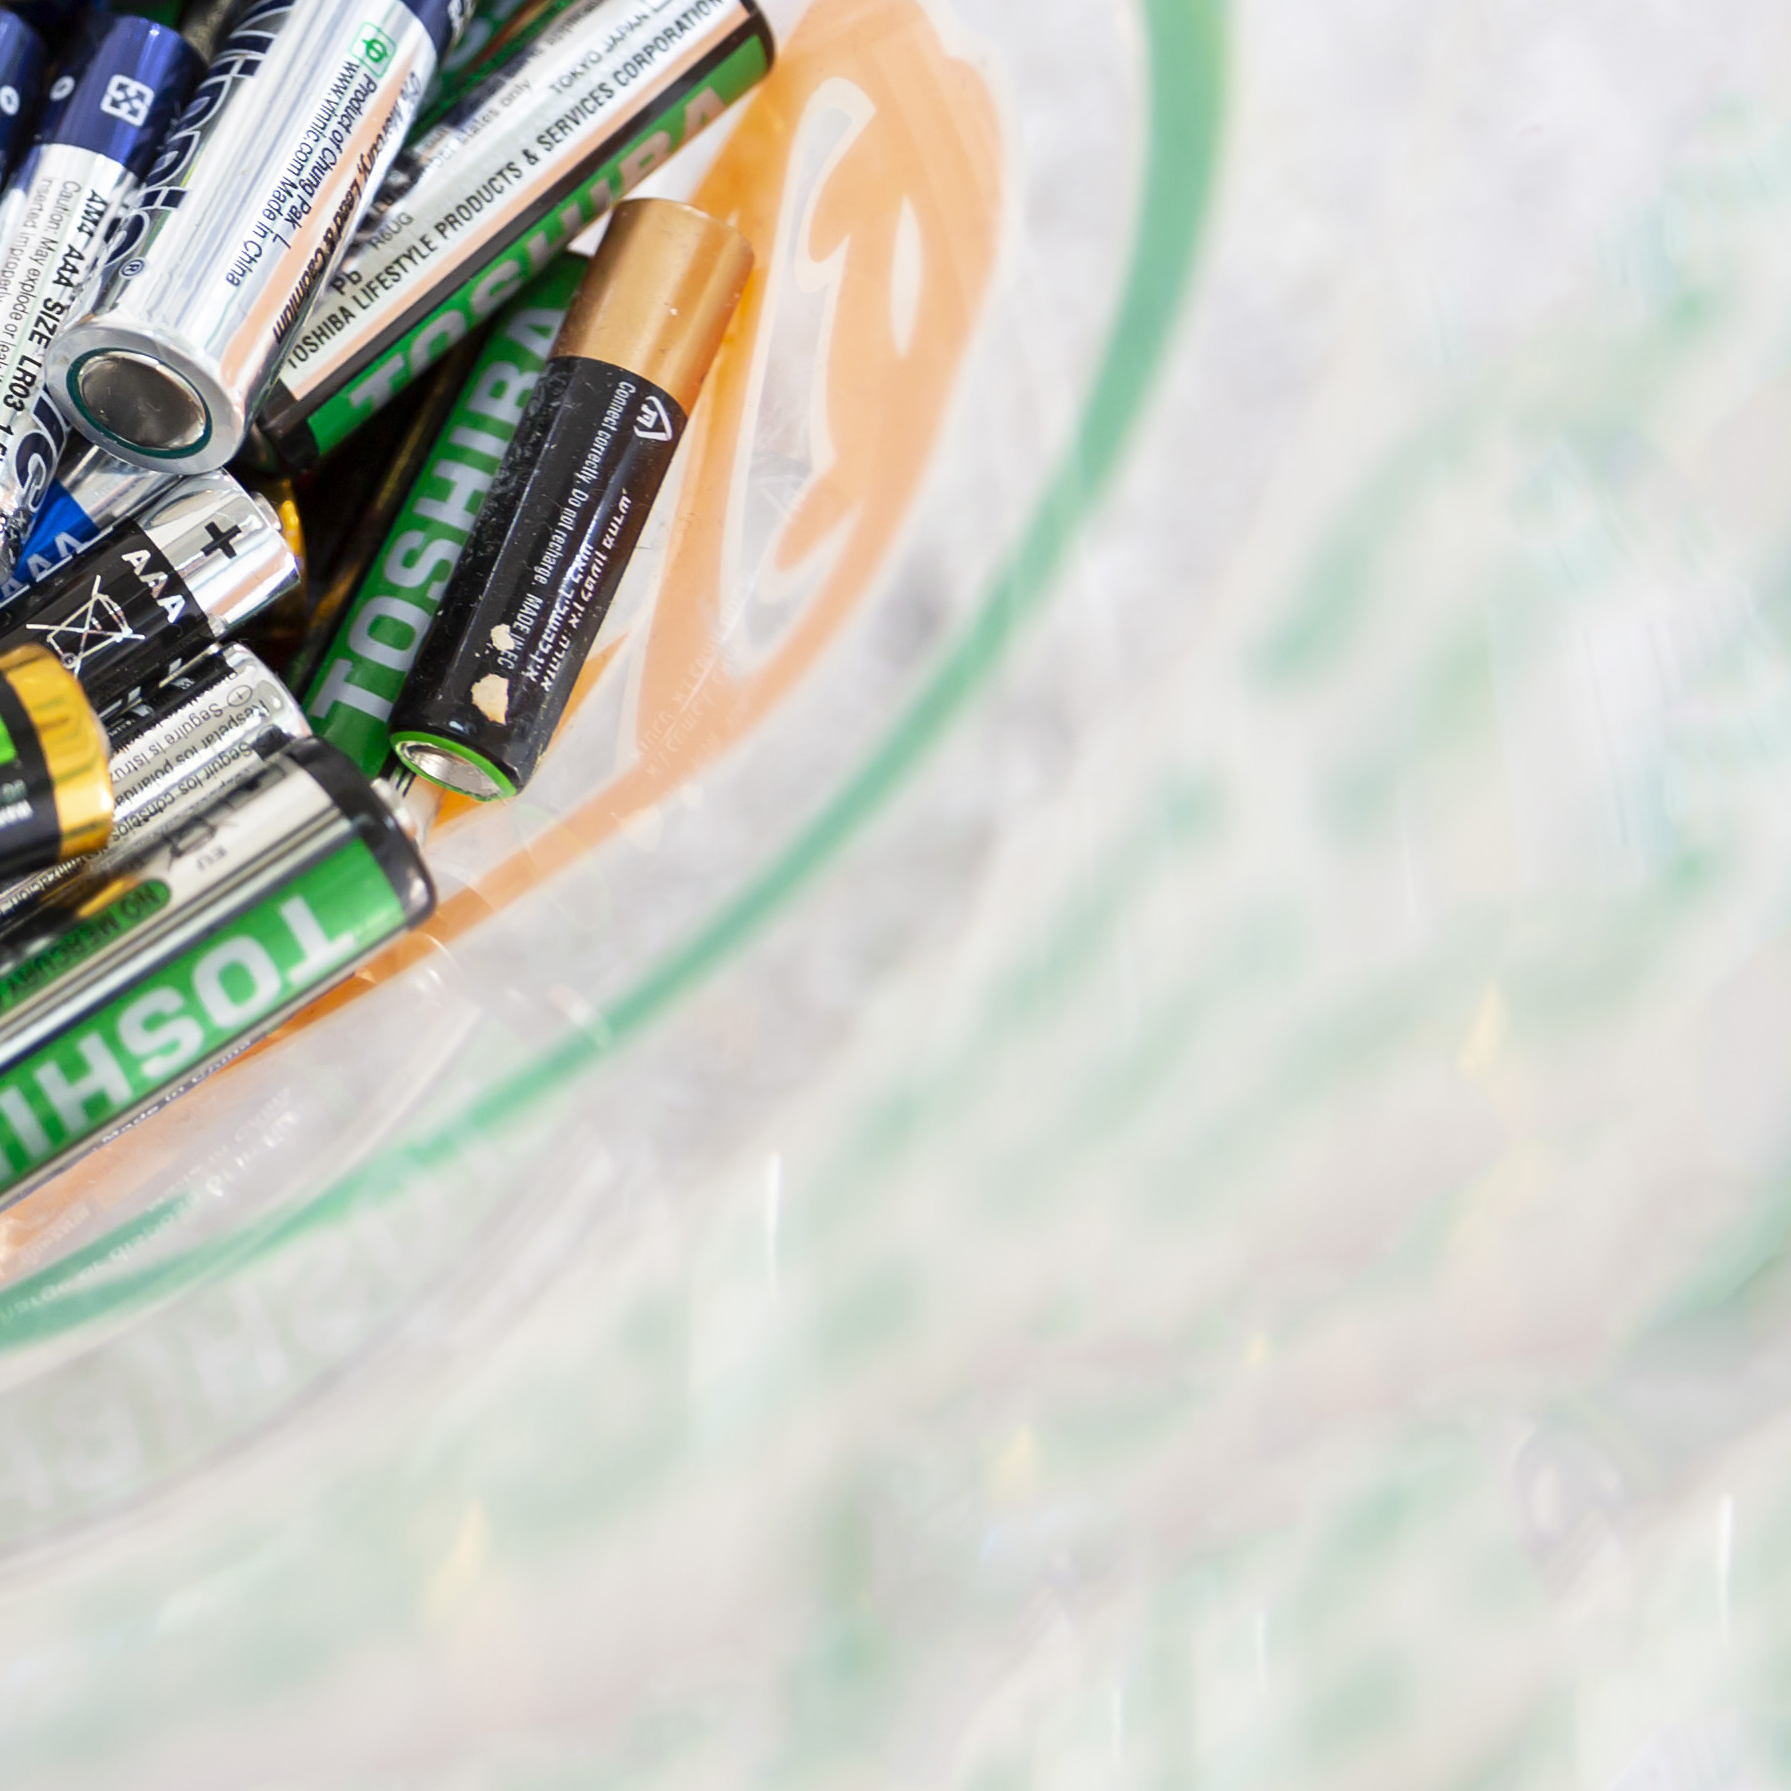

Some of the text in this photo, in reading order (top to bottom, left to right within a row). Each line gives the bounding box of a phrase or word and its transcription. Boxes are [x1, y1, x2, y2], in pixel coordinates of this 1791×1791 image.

[223, 56, 360, 290] www.vinnic.com Made in China
[281, 71, 380, 232] Product of Chung Pak
[43, 177, 82, 238] Caution:
[75, 189, 110, 238] AM4
[279, 300, 360, 371] TOSHIBA
[348, 232, 442, 312] LIFESTYLE
[430, 158, 527, 241] PRODUCTS
[518, 144, 542, 168] &
[533, 79, 619, 154] SERVICES
[29, 234, 58, 268] May
[51, 242, 88, 290] AAA
[6, 265, 43, 323] explode
[327, 262, 365, 298] Pb
[1, 322, 20, 340] or
[27, 295, 66, 350] SIZE
[0, 352, 44, 414] LR03
[600, 379, 638, 433] Connect
[571, 427, 616, 490] correctly.
[312, 309, 566, 722] TOSHIBA
[557, 506, 580, 531] not
[566, 486, 590, 510] Do
[121, 549, 185, 623] AAA
[528, 527, 571, 590] recharge.
[511, 591, 544, 635] MADE
[496, 649, 518, 670] EC
[1, 910, 122, 1001] MERCURY
